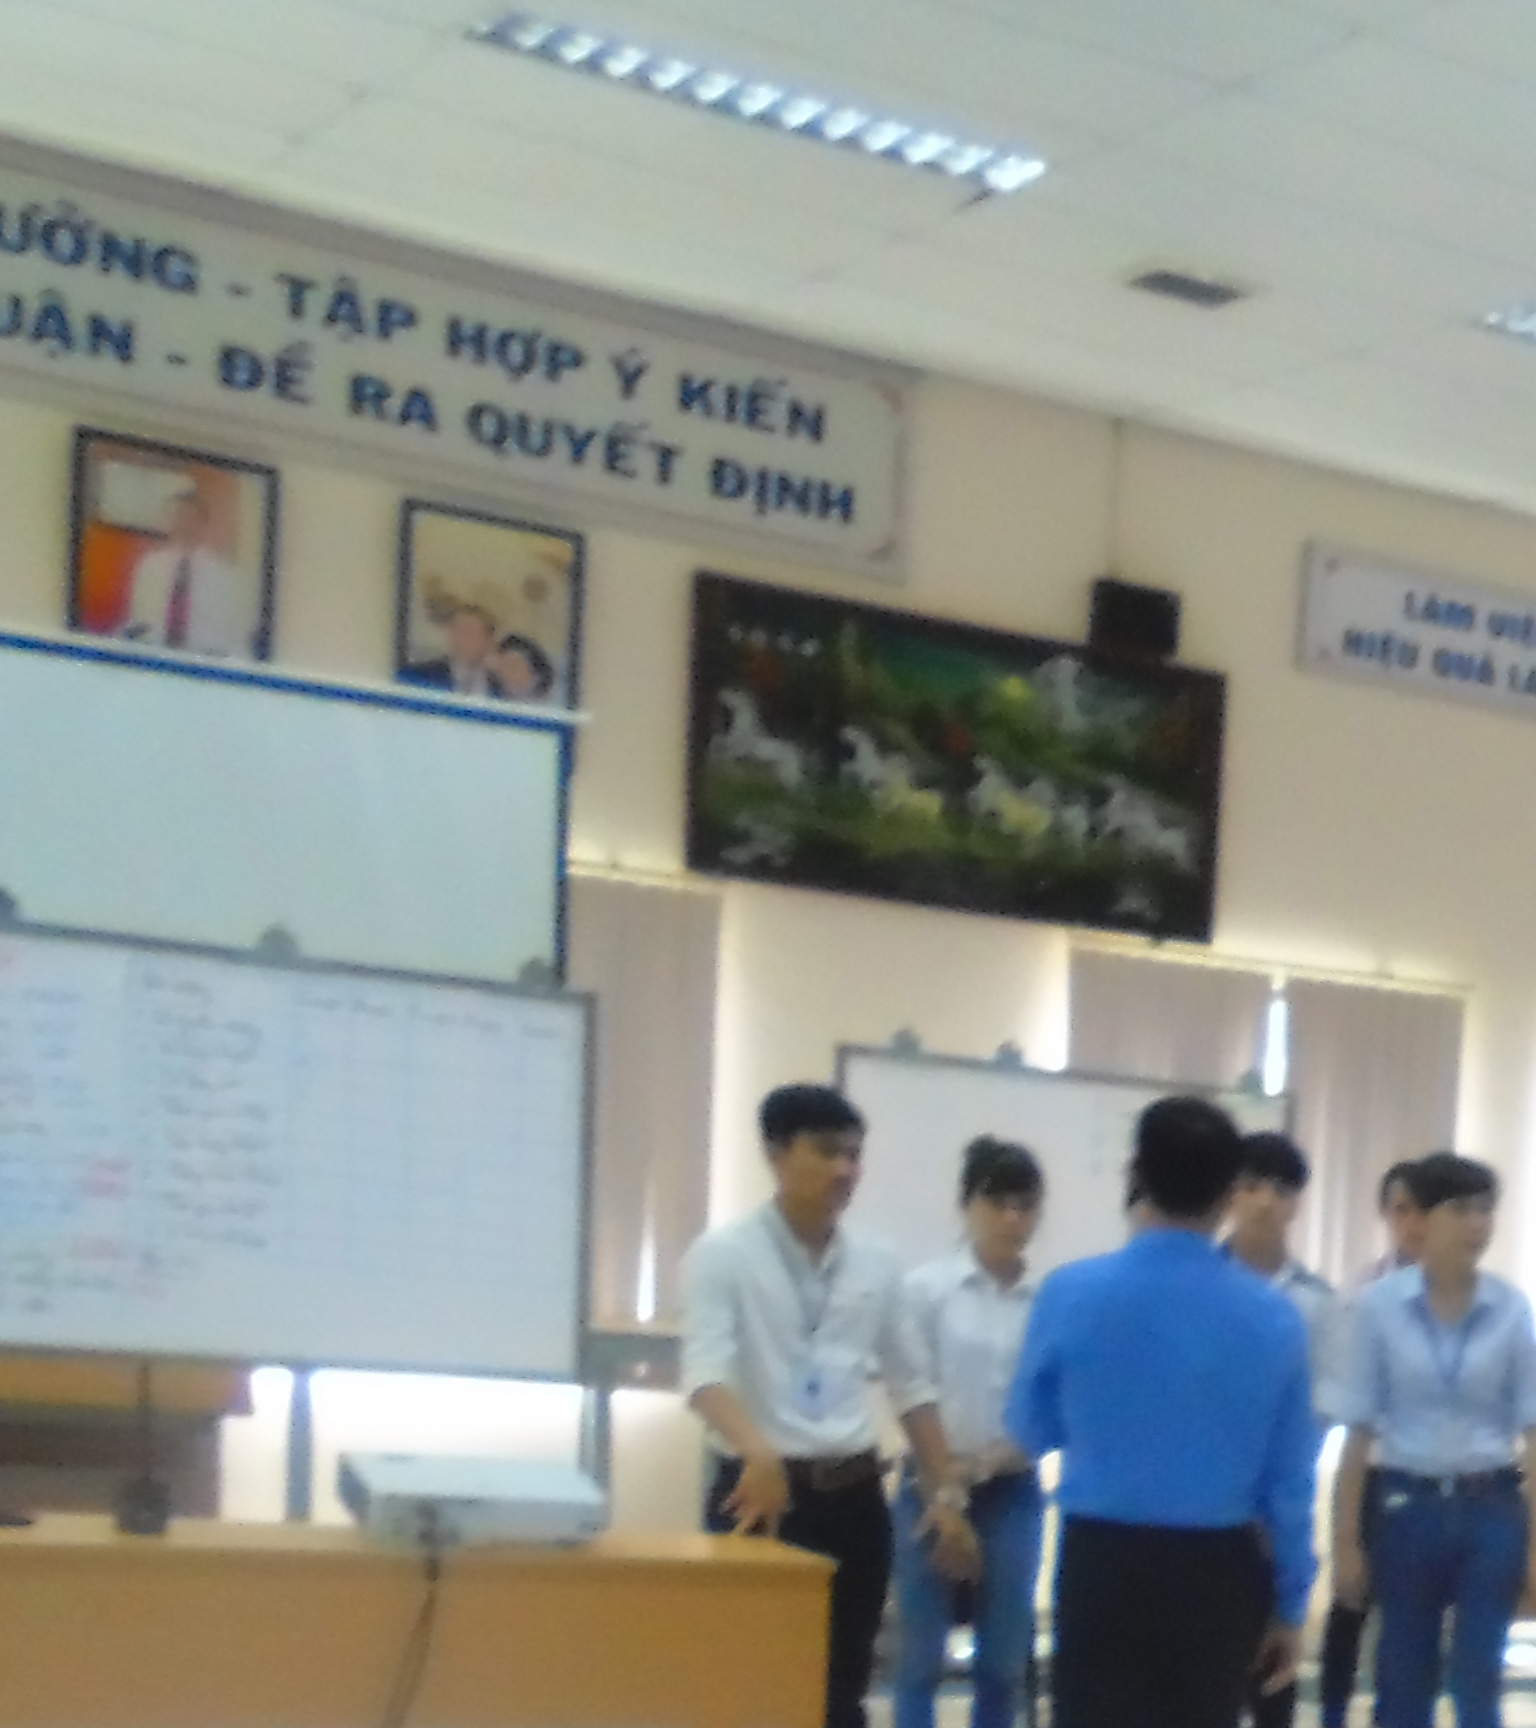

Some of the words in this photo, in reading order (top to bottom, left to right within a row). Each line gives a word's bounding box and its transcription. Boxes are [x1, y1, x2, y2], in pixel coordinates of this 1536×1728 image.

[275, 270, 416, 340] TẬP
[444, 314, 586, 384] HỢP
[608, 346, 650, 400] Ý
[677, 373, 828, 444] KIẾN
[348, 373, 440, 434] RA
[464, 403, 686, 485] QUYẾT
[708, 456, 858, 526] ĐỊNH
